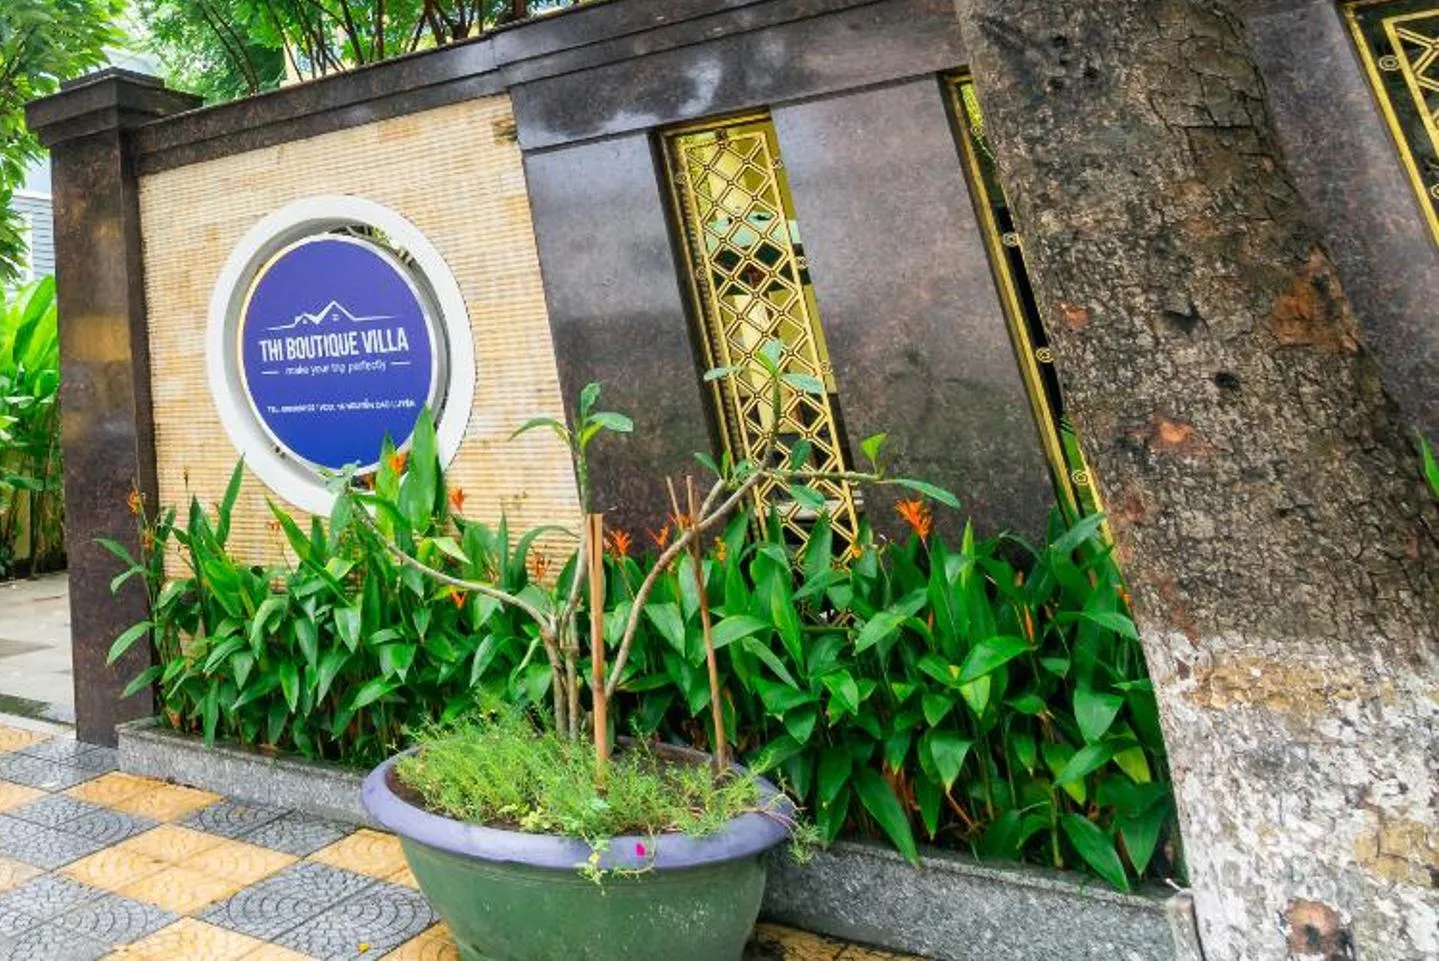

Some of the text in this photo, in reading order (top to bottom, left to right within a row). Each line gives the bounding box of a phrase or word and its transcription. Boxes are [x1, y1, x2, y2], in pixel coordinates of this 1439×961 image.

[259, 327, 409, 362] THI BOUTIQUE VILLA
[285, 359, 387, 376] make your trip perfectly
